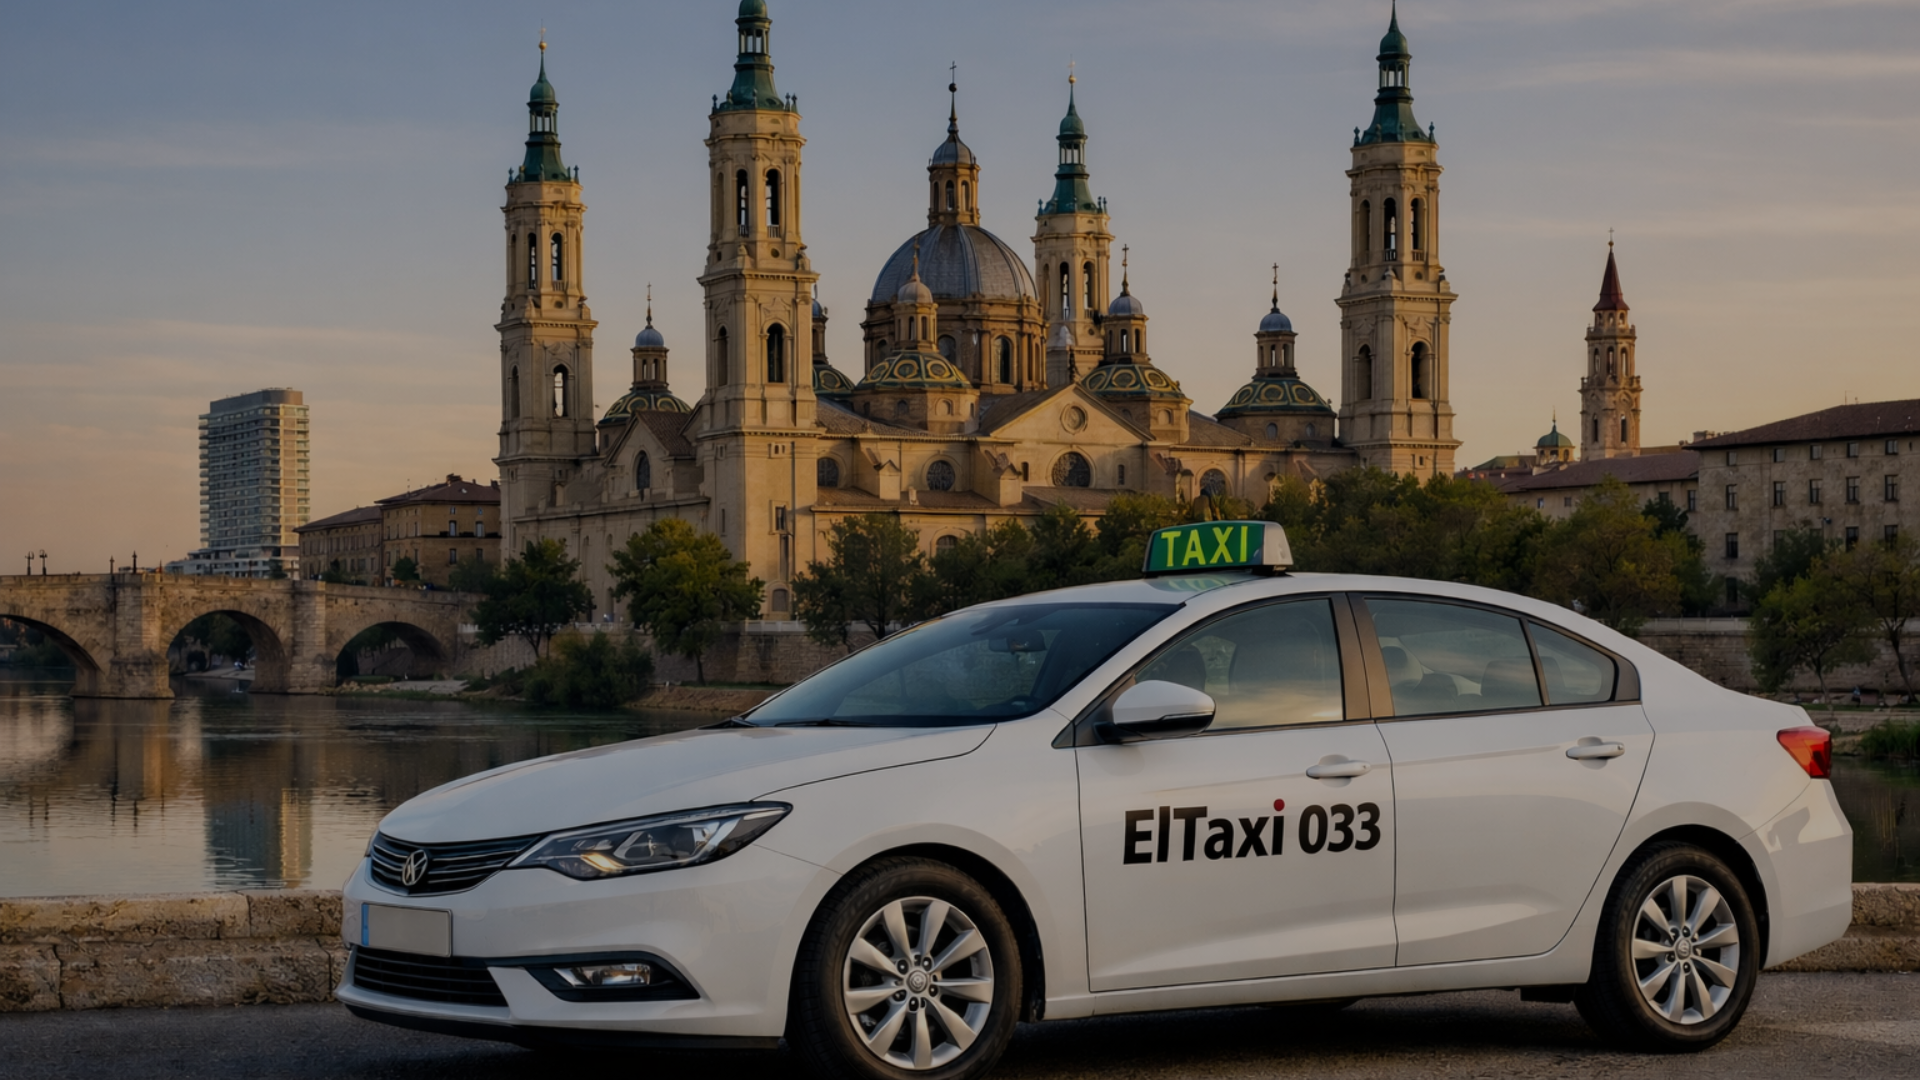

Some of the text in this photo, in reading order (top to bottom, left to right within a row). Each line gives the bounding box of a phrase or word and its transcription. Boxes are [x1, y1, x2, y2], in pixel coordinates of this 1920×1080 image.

[1161, 525, 1248, 567] TAXI
[1123, 798, 1381, 865] ElTaxi 033
